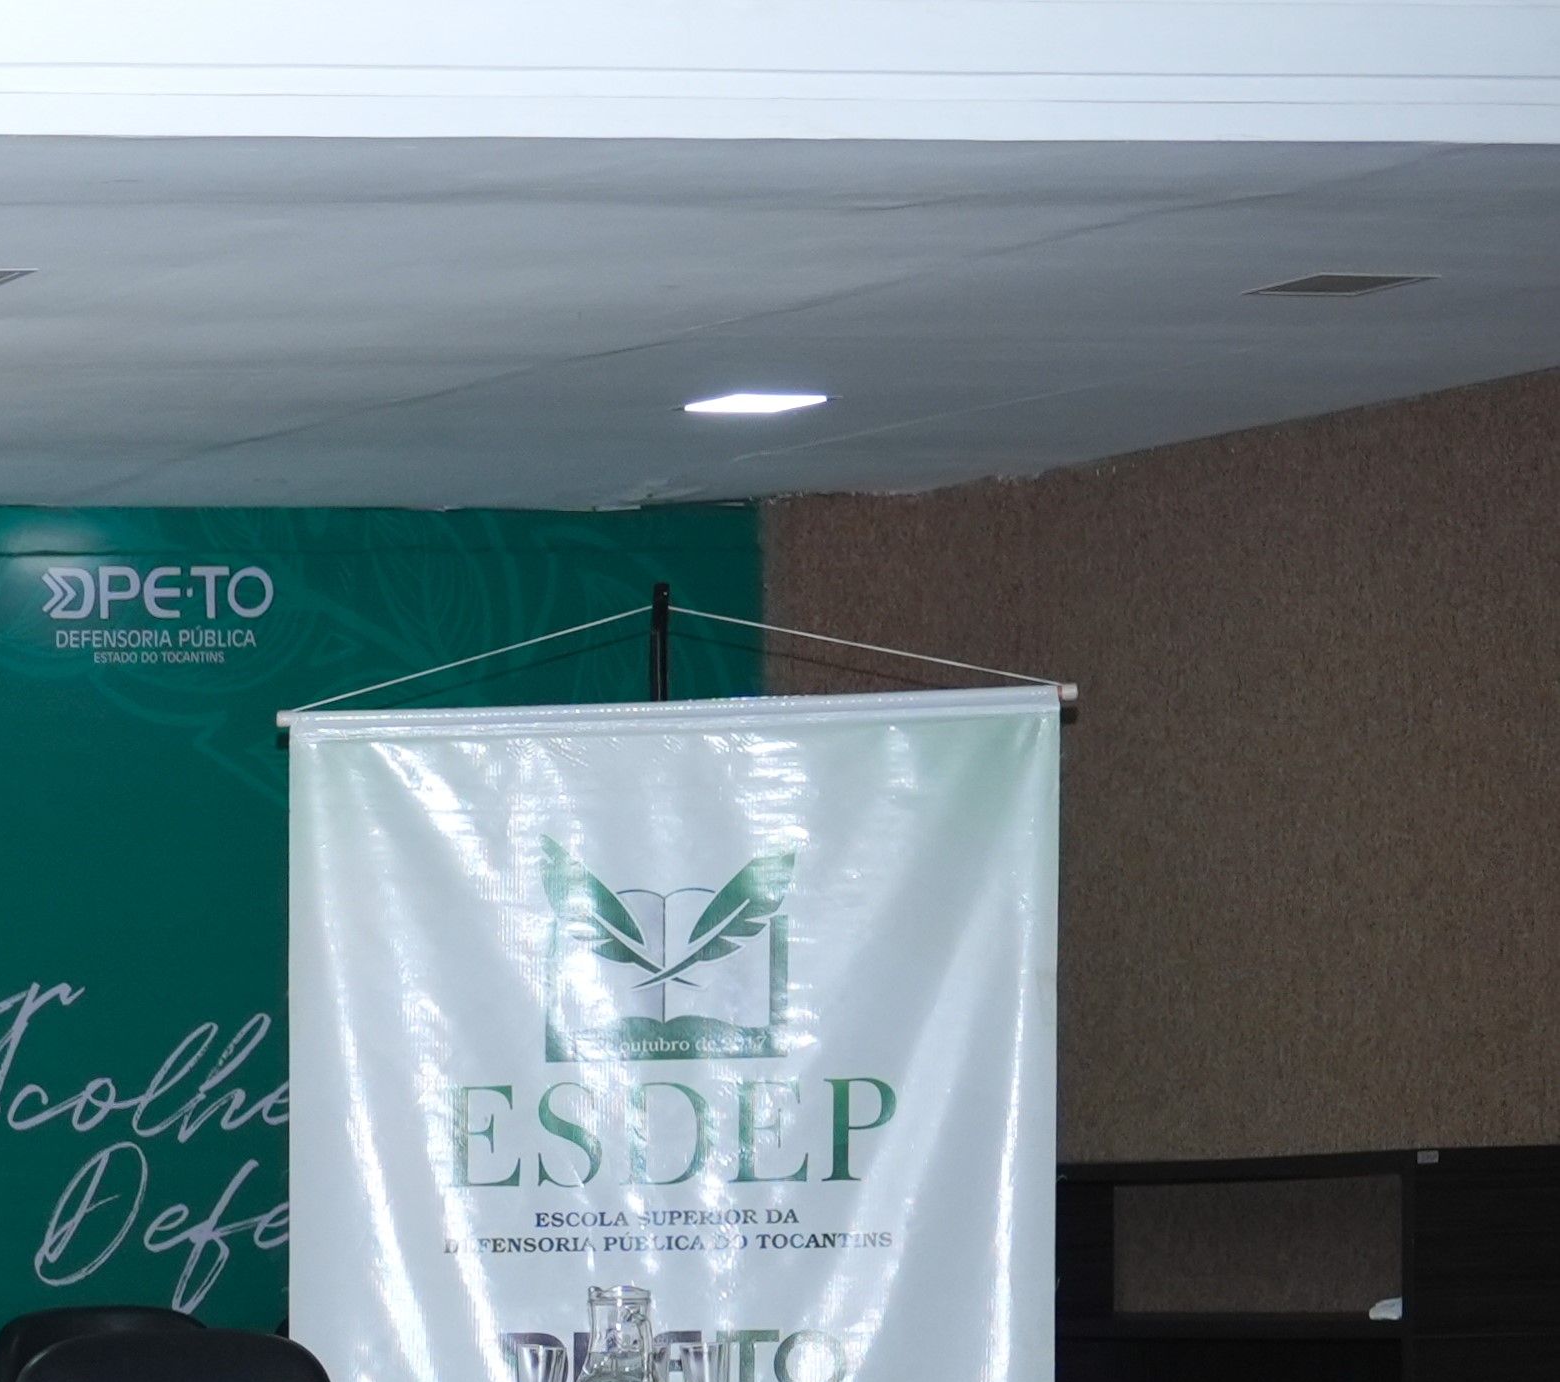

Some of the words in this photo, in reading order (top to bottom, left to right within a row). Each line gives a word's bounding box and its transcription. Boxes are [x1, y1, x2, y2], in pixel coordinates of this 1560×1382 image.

[55, 628, 172, 649] DEFENSORIA
[179, 624, 257, 648] PÚBLICA
[93, 651, 138, 664] ESTADO
[141, 651, 158, 664] DO
[162, 650, 225, 664] TOCANTINS
[620, 1036, 691, 1053] outubro
[446, 1077, 898, 1188] ESDEP
[535, 1211, 629, 1228] ESCOLA
[638, 1208, 759, 1227] SUPERIOR
[766, 1208, 800, 1225] DA
[443, 1236, 596, 1254] DFENSORIA
[603, 1231, 704, 1251] PÚBLICA
[756, 1231, 893, 1250] TOCANTINS
